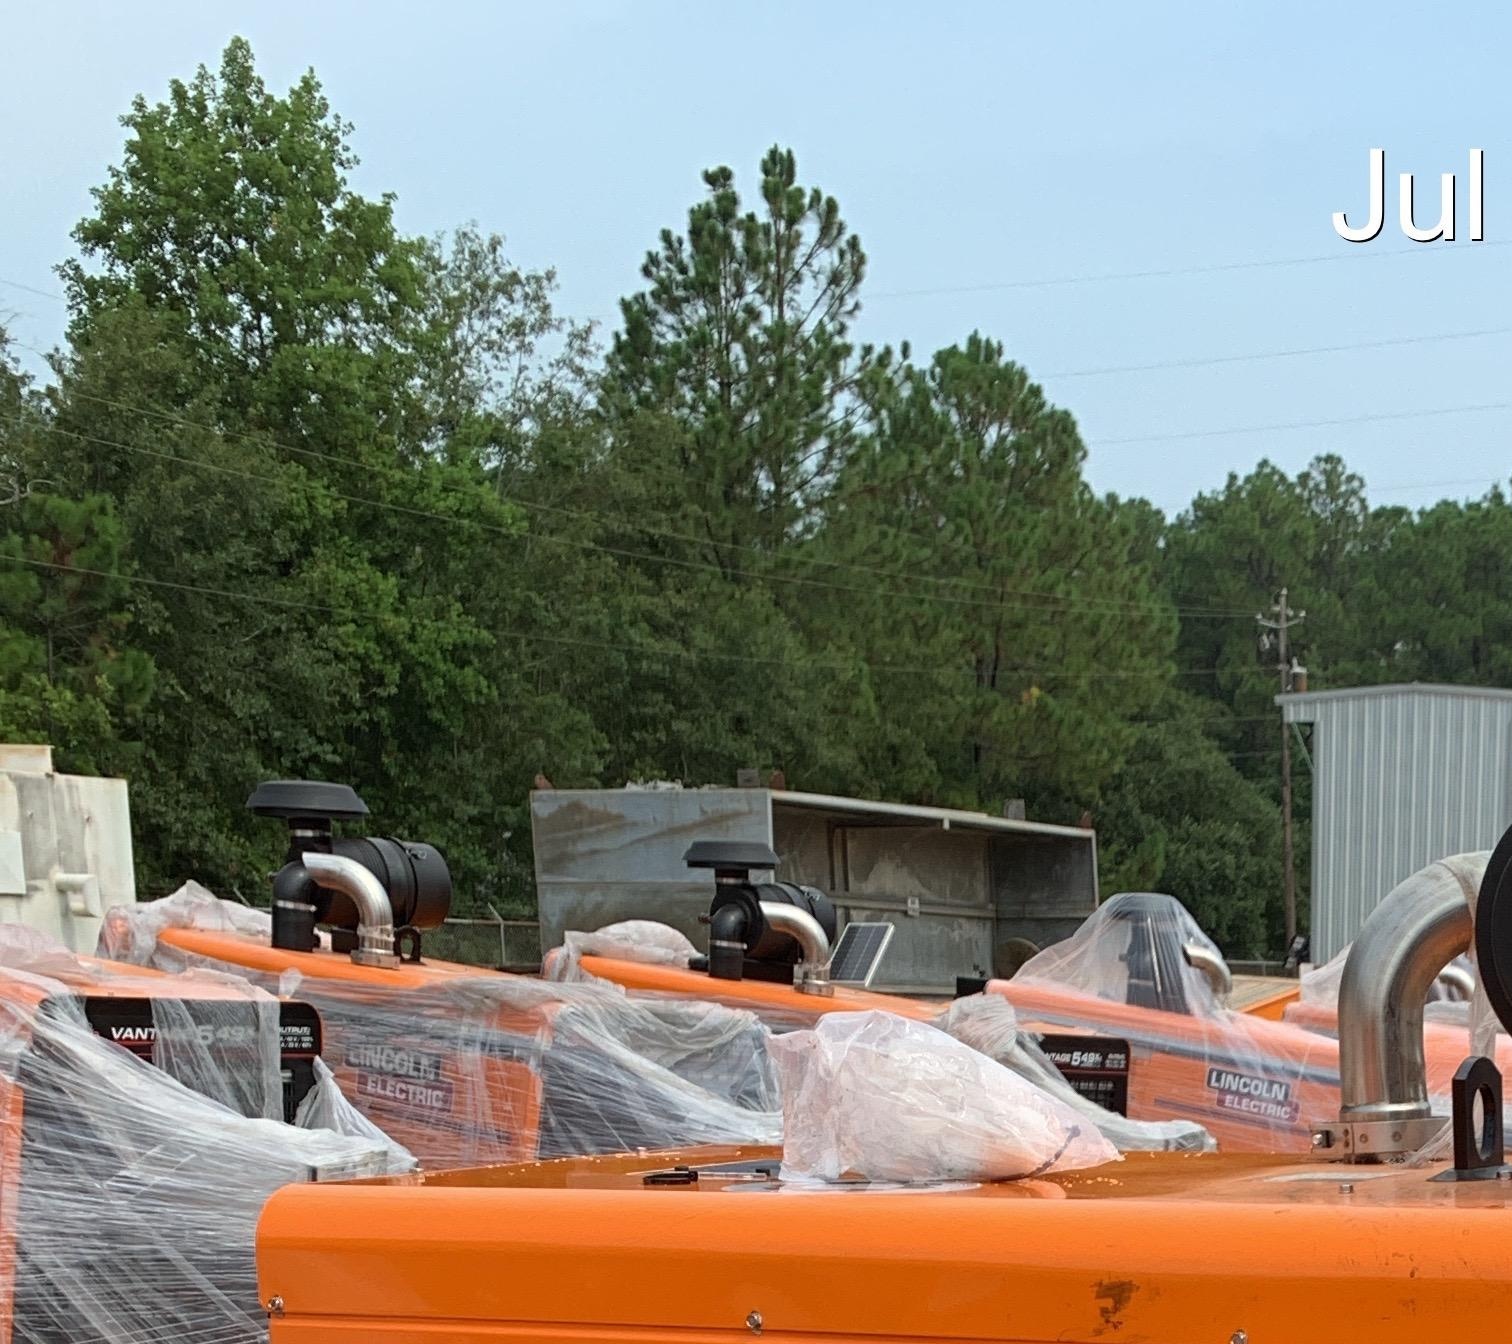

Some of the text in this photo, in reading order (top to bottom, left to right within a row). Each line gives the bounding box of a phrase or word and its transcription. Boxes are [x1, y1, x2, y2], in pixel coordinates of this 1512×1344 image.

[367, 1075, 445, 1106] ELECTRIC
[1210, 1068, 1287, 1101] LINCOLN
[1224, 1094, 1291, 1119] ELECTRIC
